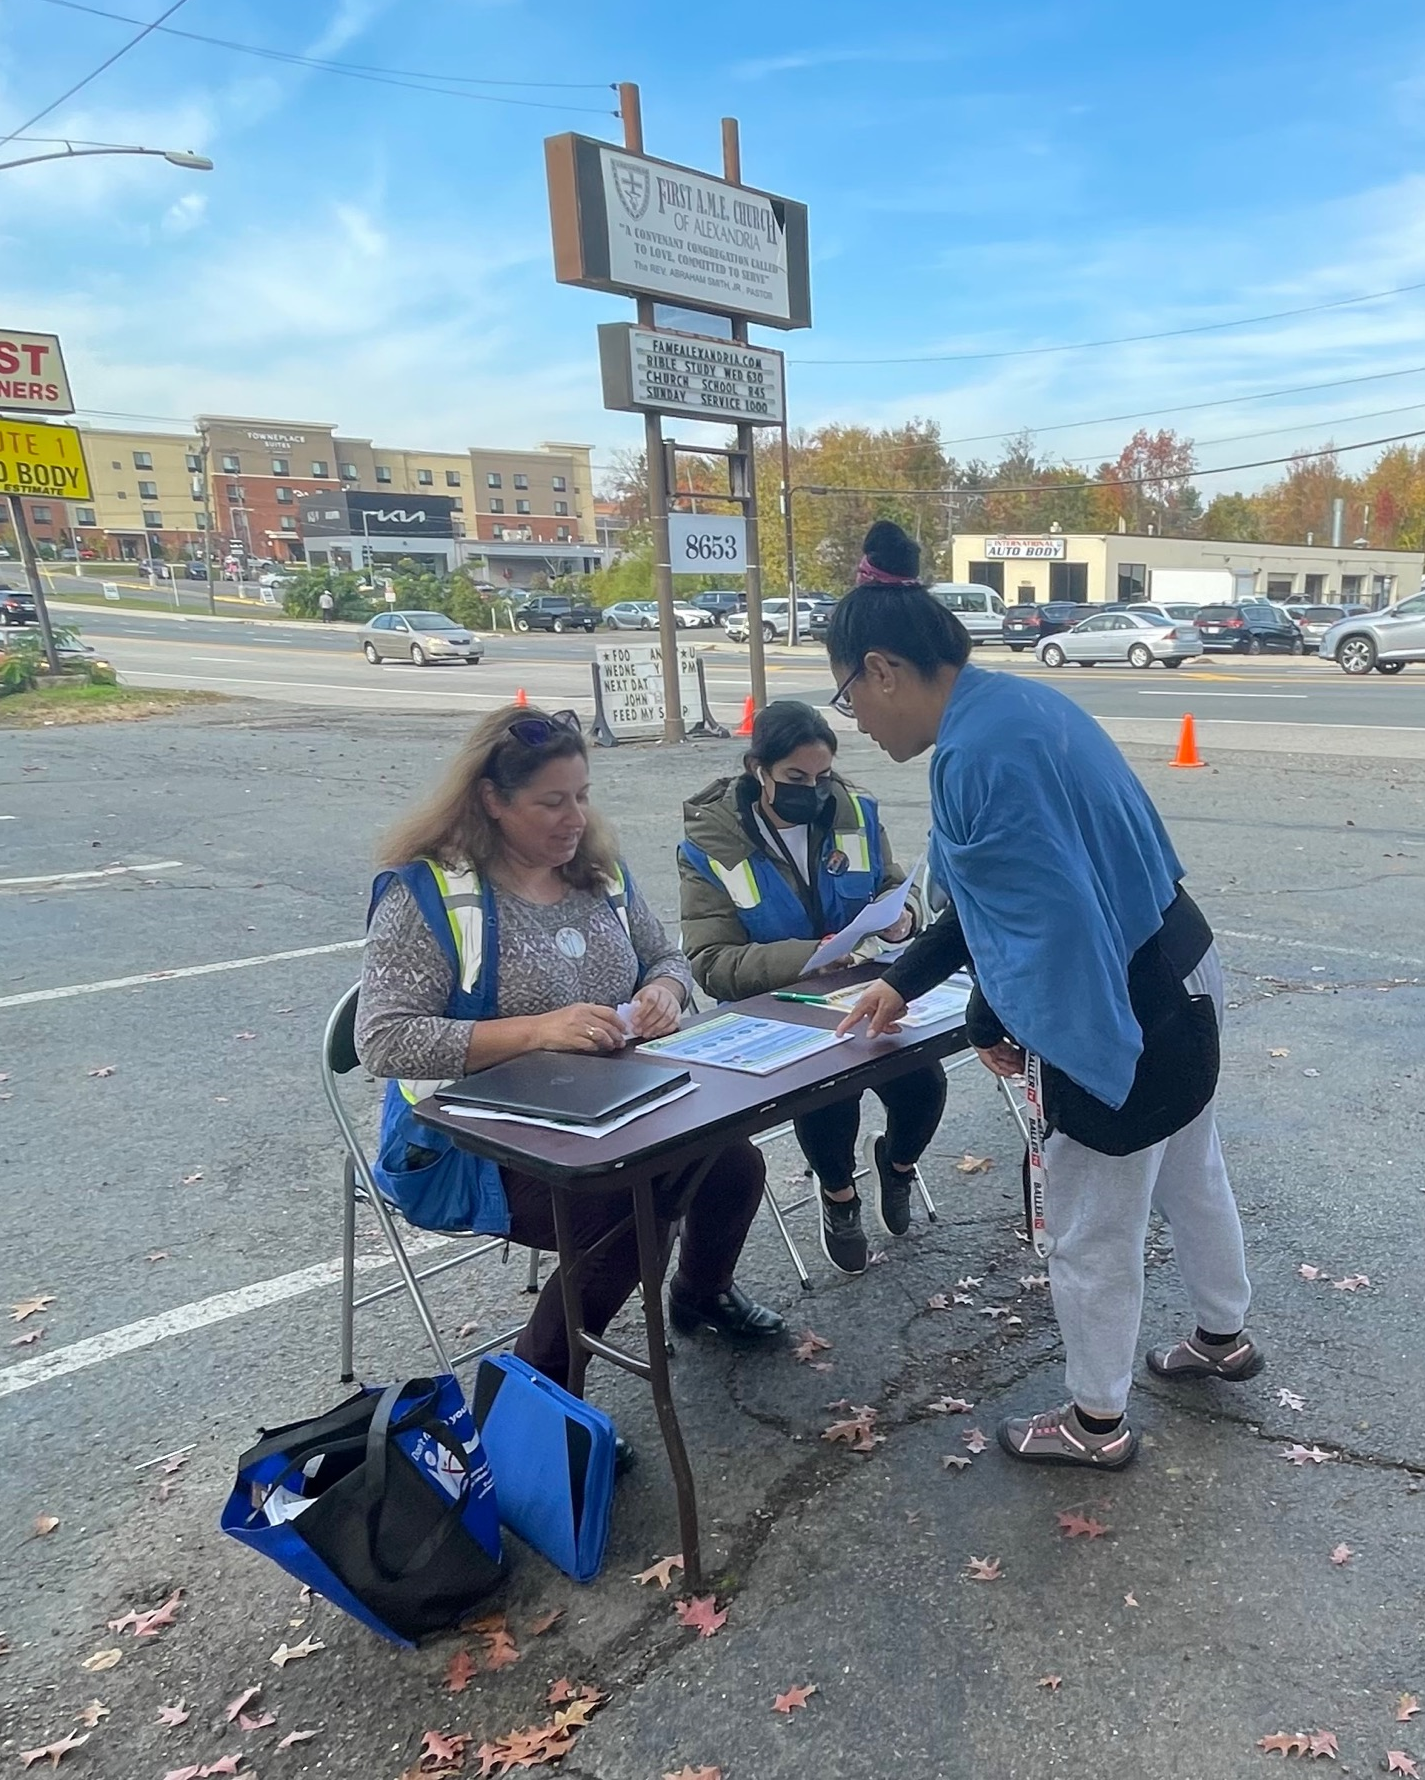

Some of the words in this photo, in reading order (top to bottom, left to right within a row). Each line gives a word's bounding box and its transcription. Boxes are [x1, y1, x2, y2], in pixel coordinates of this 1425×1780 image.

[656, 176, 693, 214] FIRST
[696, 188, 730, 222] A.M.E.
[733, 200, 778, 246] CHURCH
[673, 212, 689, 232] OF
[693, 217, 761, 252] ALEXANDRIA
[634, 242, 647, 255] TO
[678, 253, 726, 275] COMMITTED
[728, 266, 740, 279] TO
[687, 241, 749, 267] CONGREGATION
[751, 258, 778, 274] CALLED
[634, 259, 648, 272] The
[669, 268, 706, 284] ABRAHAM
[746, 286, 773, 301] PASTOR
[646, 354, 677, 370] BIBLE
[685, 360, 716, 378] STUDY
[724, 367, 744, 382] WED
[746, 370, 764, 384] 630
[652, 339, 762, 370] FAMEALEXANDRIA.COM
[646, 370, 690, 389] CHURCH
[702, 378, 738, 395] SCHOOL
[646, 385, 686, 402] SUNDAY
[701, 393, 742, 411] SERVICE
[745, 399, 768, 415] 1000
[4, 483, 65, 496] ESTIMATE
[16, 461, 79, 489] BODY
[685, 534, 738, 560] 8653
[988, 547, 1020, 556] AUTO
[1026, 547, 1061, 556] BODY
[604, 679, 627, 692] NEXT
[624, 692, 648, 707] JOHN
[613, 709, 637, 721] FEED
[641, 707, 654, 720] MY
[1033, 1181, 1044, 1218] BALLER
